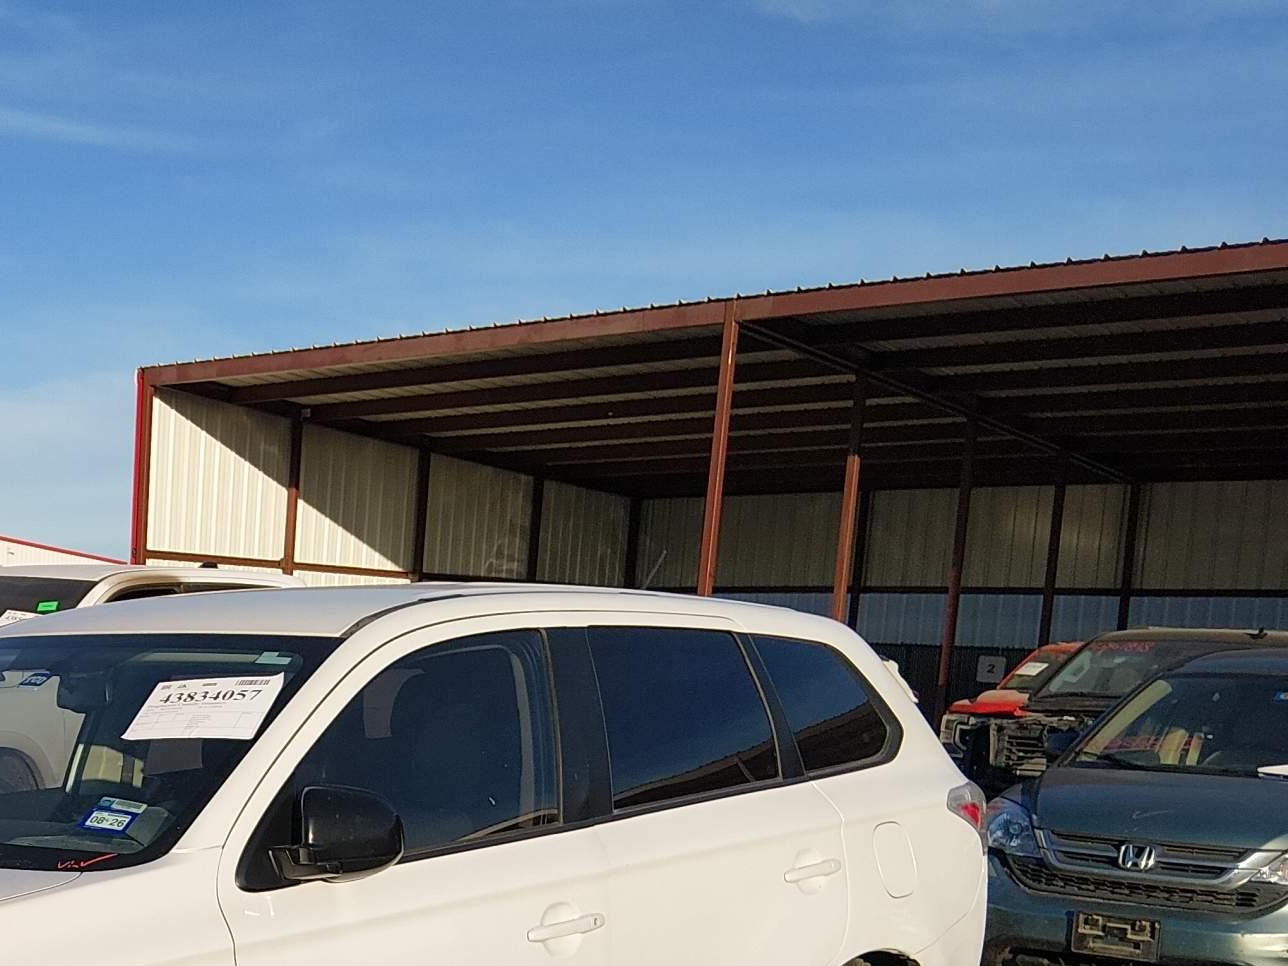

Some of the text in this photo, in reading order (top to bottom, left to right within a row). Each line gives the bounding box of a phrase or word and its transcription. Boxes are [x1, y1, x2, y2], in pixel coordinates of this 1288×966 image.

[987, 663, 996, 674] 2
[159, 689, 263, 704] 43834057
[89, 815, 126, 828] 08 26
